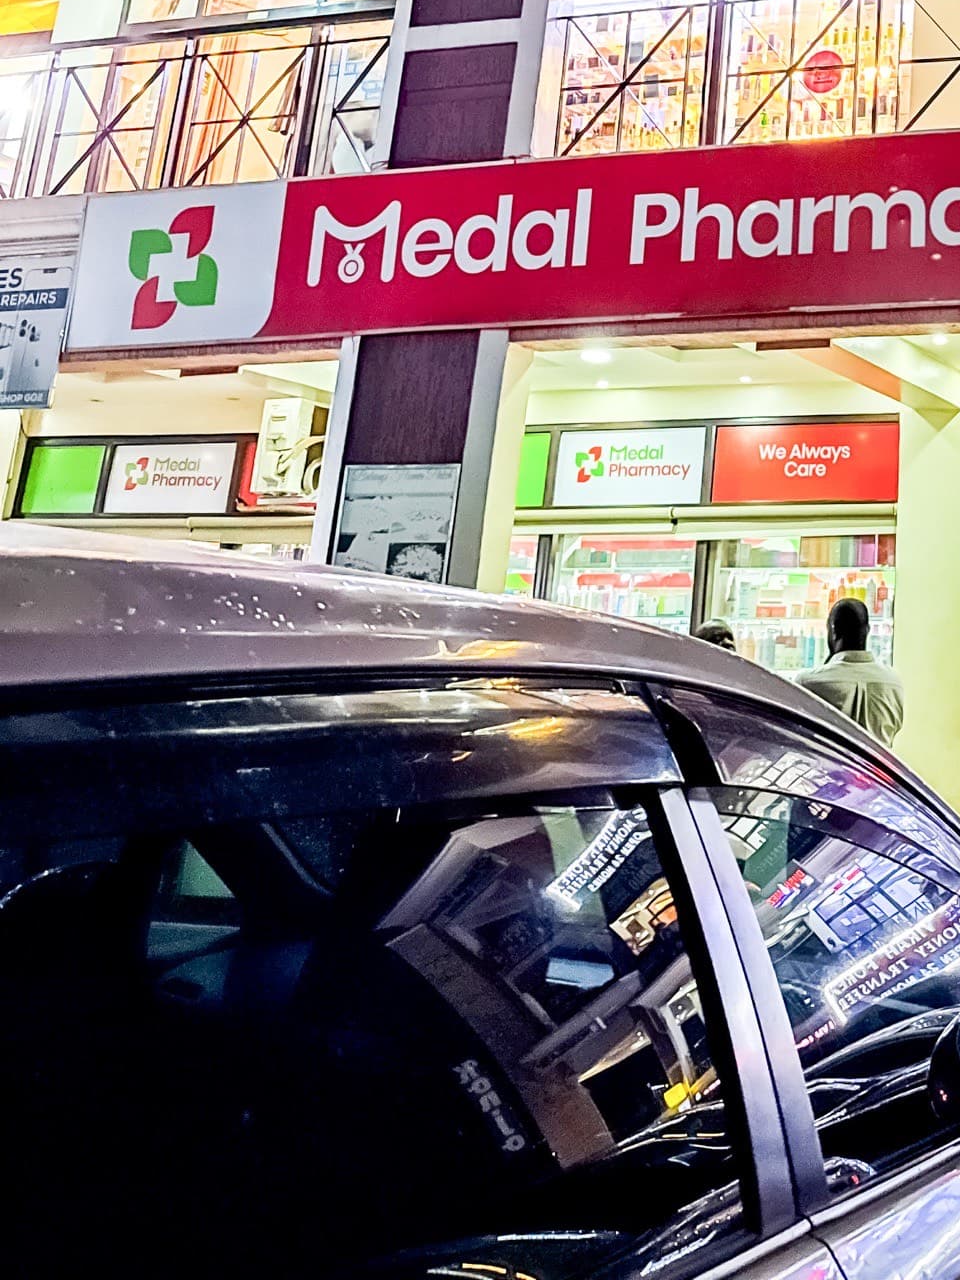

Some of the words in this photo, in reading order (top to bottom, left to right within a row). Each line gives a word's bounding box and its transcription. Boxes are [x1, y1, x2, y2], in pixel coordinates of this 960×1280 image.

[306, 187, 589, 288] Medal
[1, 291, 57, 307] REPAIRS
[609, 444, 664, 461] Medal
[758, 443, 789, 460] We
[791, 442, 851, 462] Always
[154, 457, 201, 472] Medal
[608, 463, 691, 481] Pharmacy
[784, 460, 827, 477] Care
[151, 473, 223, 491] Pharmacy
